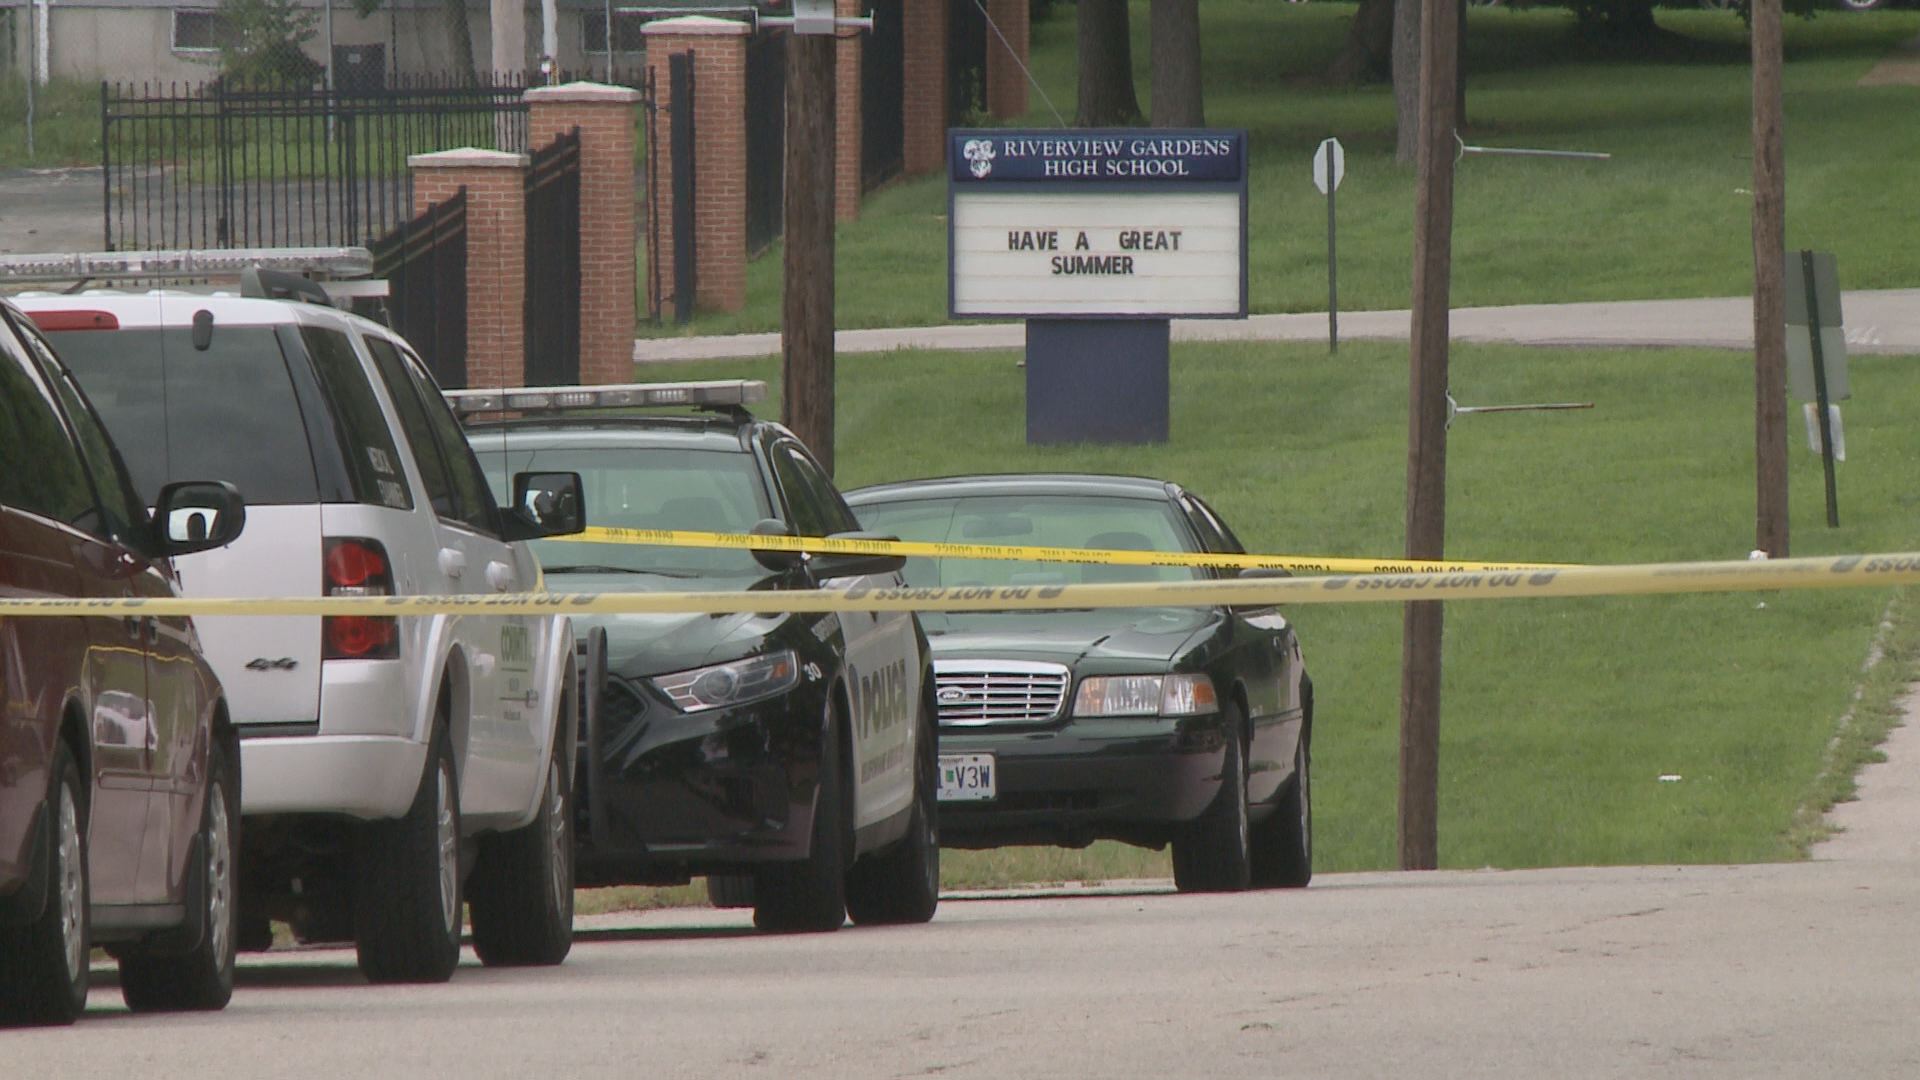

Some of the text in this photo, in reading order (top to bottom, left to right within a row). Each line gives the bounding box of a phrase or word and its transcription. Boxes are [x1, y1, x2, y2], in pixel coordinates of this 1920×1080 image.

[1004, 140, 1230, 156] RIVERVIEW GARDENS
[1044, 159, 1189, 176] HIGH SCHOOL
[1008, 231, 1182, 250] HAVE A GREAT
[1051, 255, 1134, 275] SUMMER
[803, 661, 822, 681] 30
[861, 657, 906, 740] POLICE
[955, 765, 990, 790] V3W
